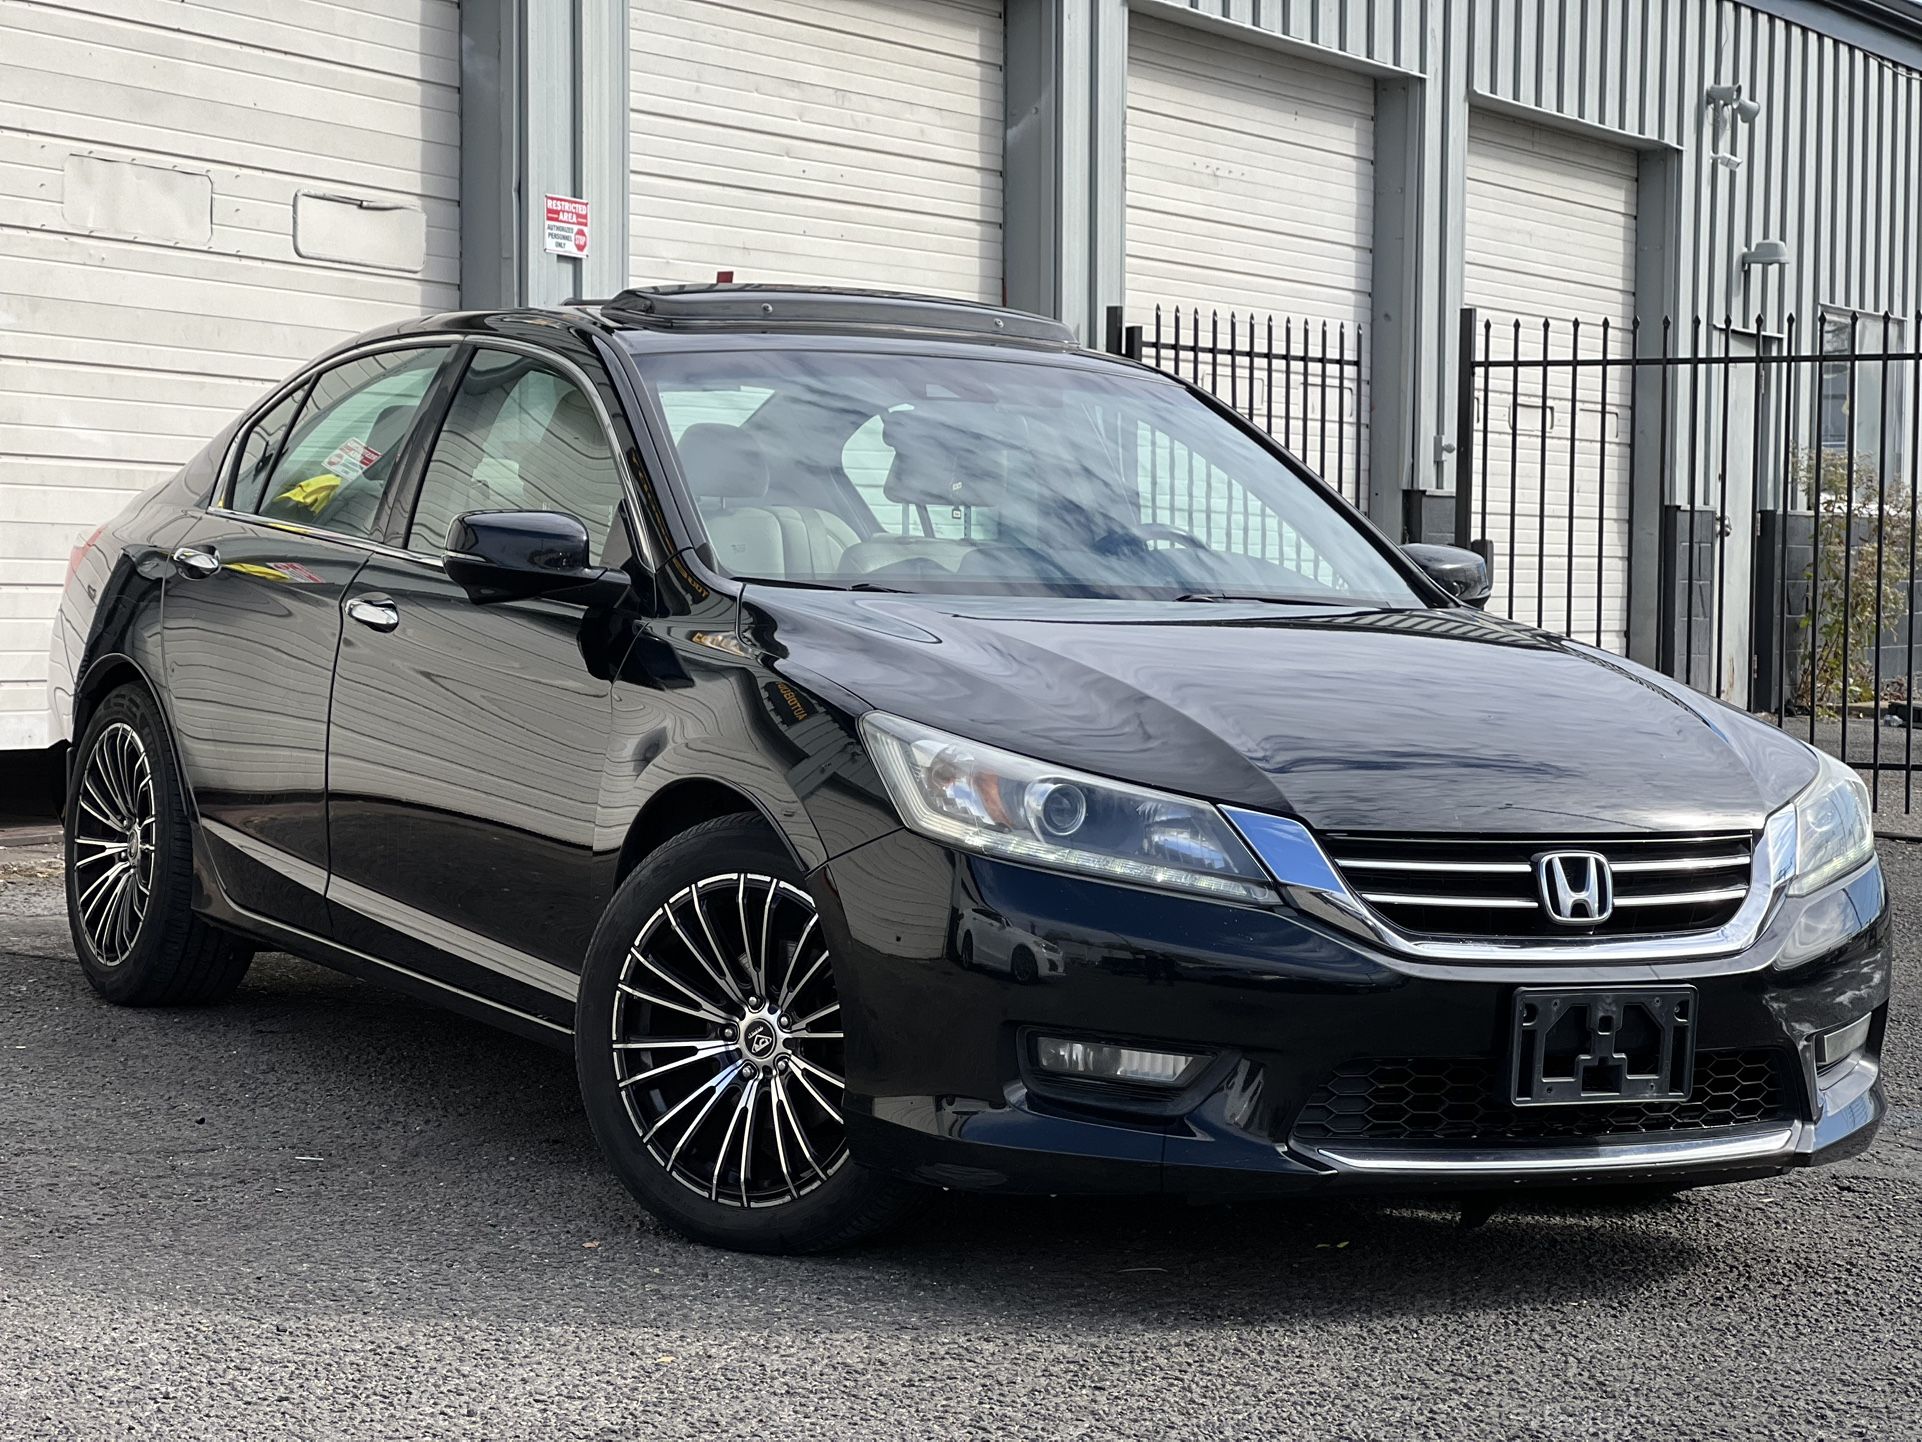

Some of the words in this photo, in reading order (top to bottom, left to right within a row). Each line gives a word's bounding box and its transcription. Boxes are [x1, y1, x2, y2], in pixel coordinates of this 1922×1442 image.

[547, 199, 586, 215] RESTRICTED
[558, 212, 576, 223] AREA
[547, 224, 573, 234] AUTHORIZED
[548, 232, 572, 242] PERSONNEL
[575, 235, 586, 246] STOP
[555, 241, 566, 249] ONLY
